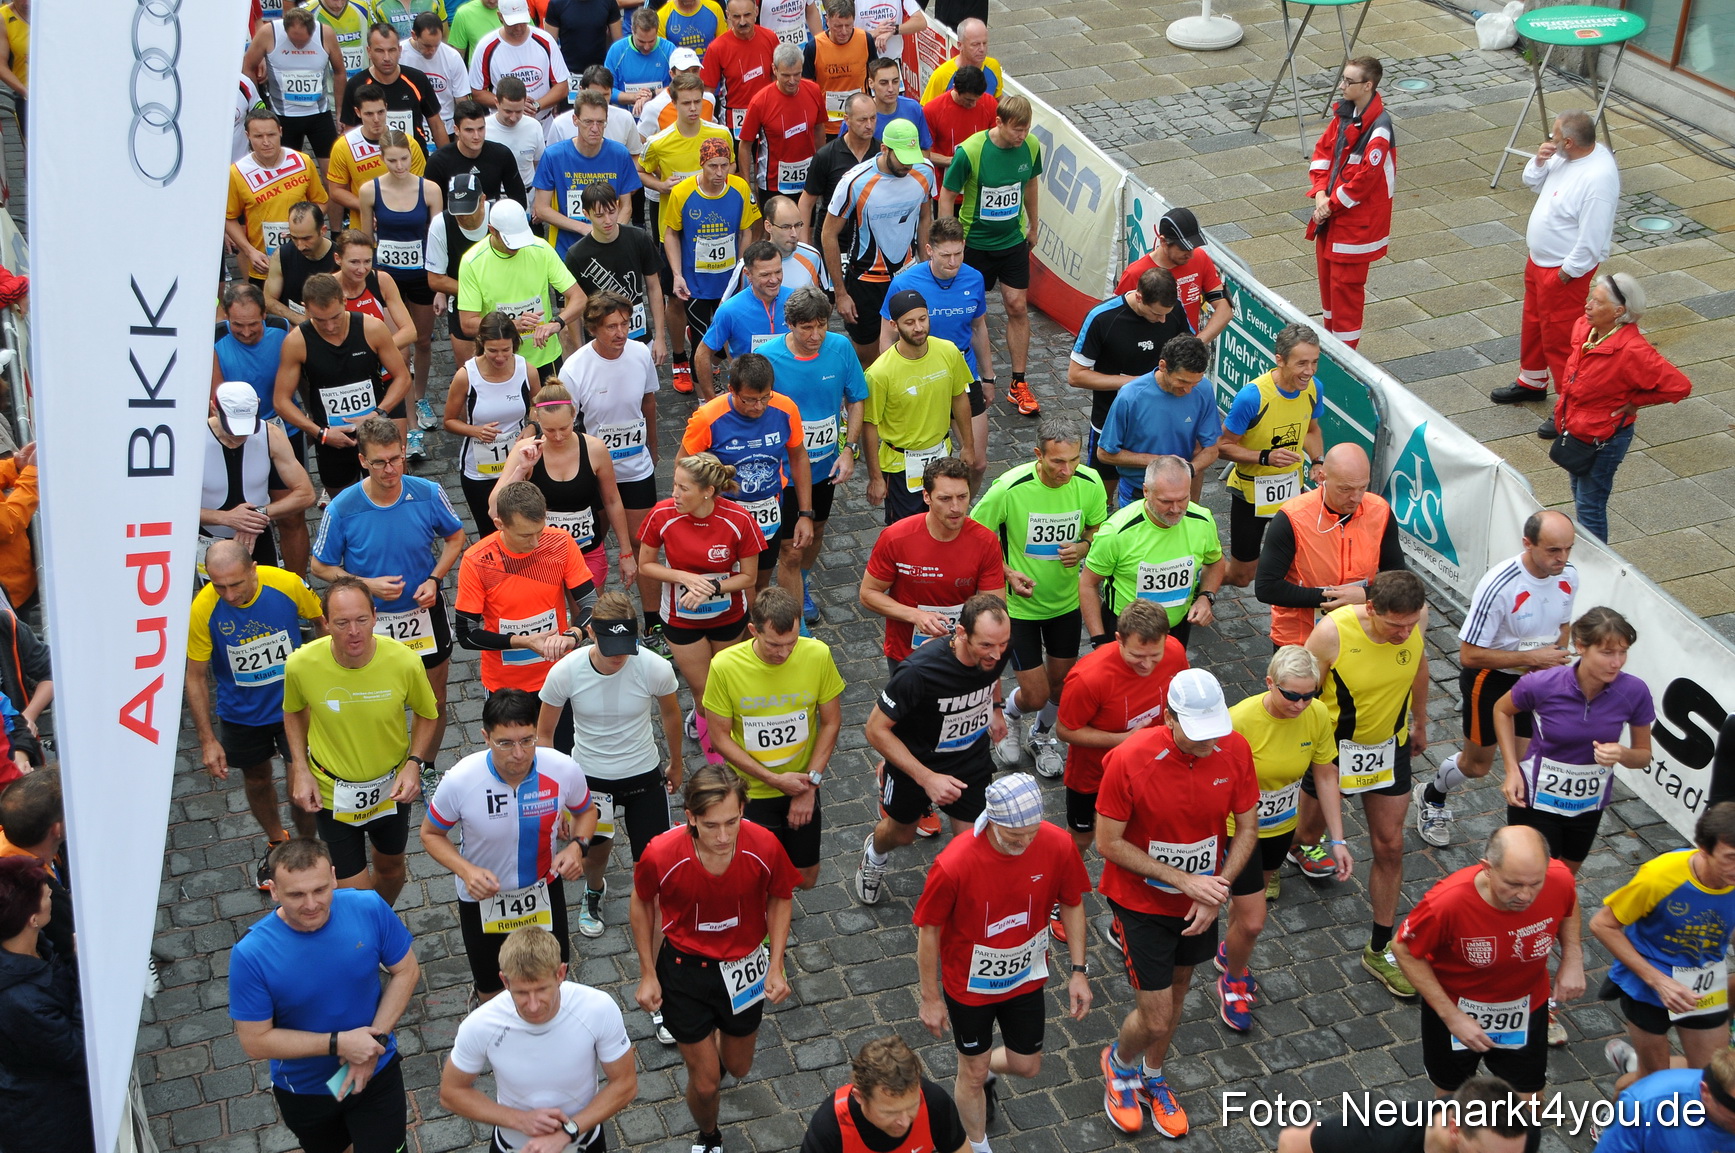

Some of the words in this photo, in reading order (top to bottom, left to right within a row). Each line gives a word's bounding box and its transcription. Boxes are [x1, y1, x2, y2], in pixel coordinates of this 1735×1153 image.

[860, 8, 890, 16] GERHART
[286, 80, 319, 93] 2057
[356, 160, 381, 174] MAX
[782, 170, 808, 182] 245
[255, 186, 282, 204] MAX
[284, 174, 311, 192] BÖGL
[986, 192, 1018, 208] 2409
[268, 232, 289, 246] 26
[382, 250, 420, 266] 3339
[708, 246, 726, 260] 49
[707, 262, 727, 270] Roland
[1224, 331, 1256, 368] Mehr
[127, 273, 179, 477] BKK
[1223, 356, 1240, 385] für
[322, 390, 339, 398] PARTL
[340, 386, 366, 396] Neumarkt
[328, 392, 372, 415] 2469
[616, 424, 638, 432] Neumarkt
[808, 422, 830, 431] Neumarkt
[602, 430, 642, 449] 2514
[805, 428, 833, 448] 742
[1274, 474, 1294, 484] Neumarkt
[1266, 481, 1293, 503] 607
[1032, 523, 1076, 543] 3350
[1140, 565, 1160, 573] PARTL
[1160, 562, 1186, 572] Neumarkt
[1412, 539, 1438, 566] Service
[1438, 560, 1460, 583] GmbH
[1143, 568, 1190, 590] 3308
[392, 610, 419, 620] Neumarkt
[521, 617, 548, 629] Neumarkt
[119, 522, 172, 745] Audi
[386, 618, 422, 640] 122
[250, 639, 278, 652] Neumarkt
[235, 644, 288, 672] 2214
[254, 670, 277, 680] Klaus
[740, 693, 800, 710] CRAFT
[766, 717, 797, 726] Neumarkt
[946, 708, 988, 740] 2095
[758, 725, 797, 748] 632
[1352, 752, 1384, 773] 324
[1542, 763, 1564, 774] PARTL
[1356, 776, 1379, 786] Harald
[1545, 774, 1600, 798] 2499
[355, 788, 380, 810] 38
[1270, 786, 1294, 799] Neumarkt
[1257, 792, 1296, 818] 2321
[1554, 798, 1585, 810] Kathrin
[354, 806, 379, 820] Martin
[1150, 845, 1175, 854] PARTL
[1176, 844, 1207, 854] Neumarkt
[505, 886, 536, 899] Neumarkt
[495, 894, 536, 917] 149
[498, 915, 538, 932] Reinhard
[1516, 917, 1554, 934] NEUMARKTER
[974, 950, 998, 958] PARTL
[722, 959, 744, 972] PARTL
[978, 951, 1032, 977] 2358
[1692, 970, 1714, 994] 40
[1460, 1000, 1484, 1012] PARTL
[1486, 1004, 1520, 1012] Neumarkt
